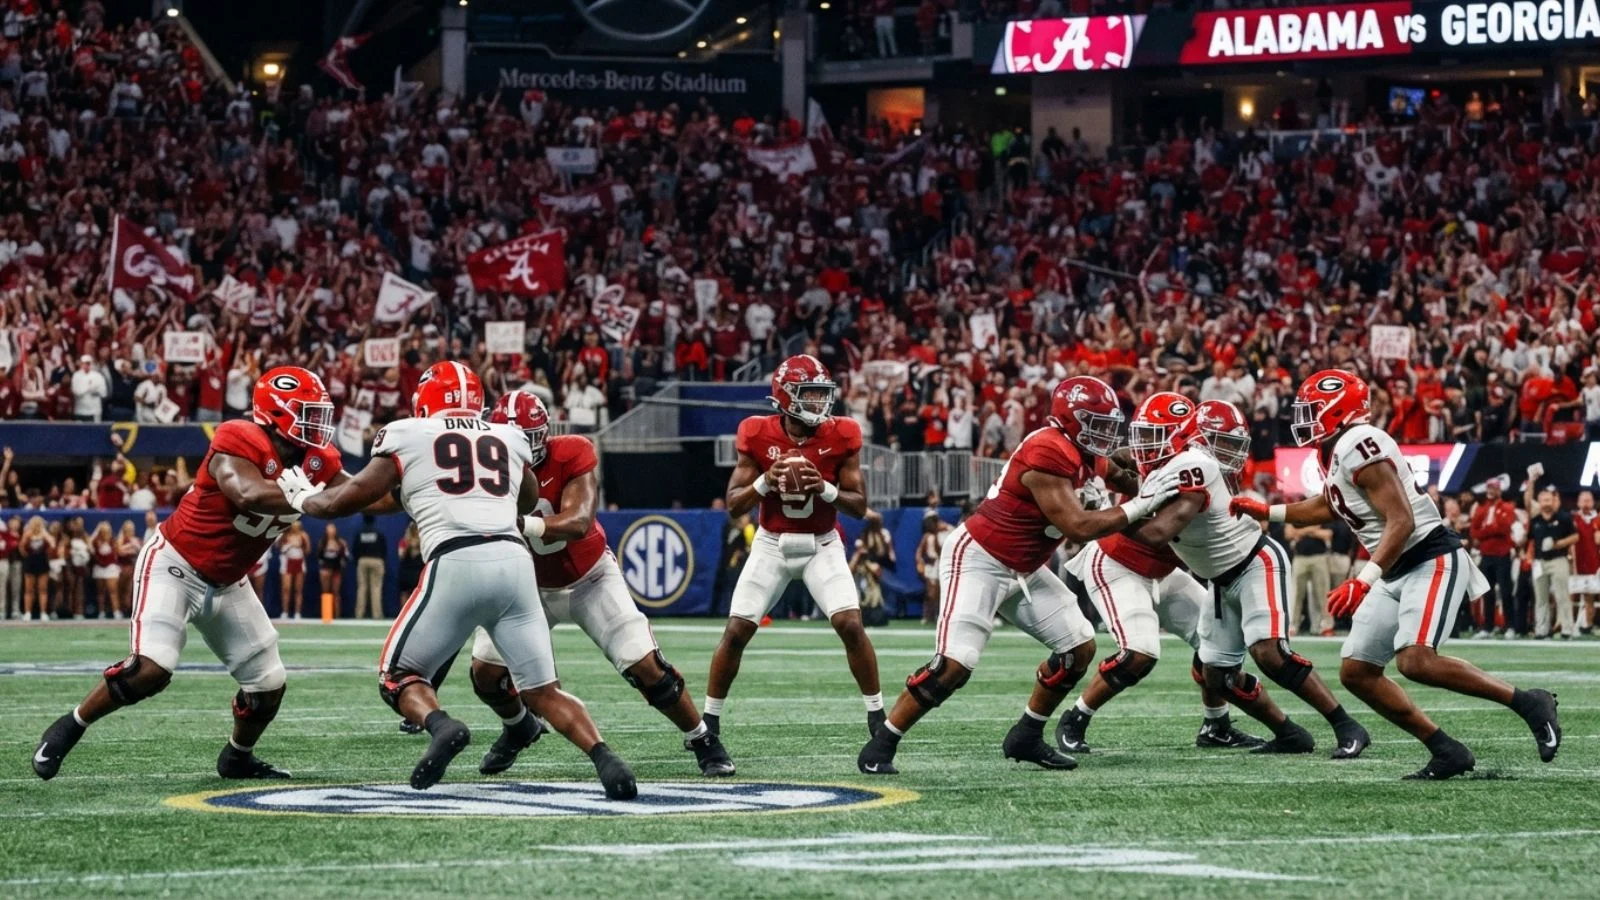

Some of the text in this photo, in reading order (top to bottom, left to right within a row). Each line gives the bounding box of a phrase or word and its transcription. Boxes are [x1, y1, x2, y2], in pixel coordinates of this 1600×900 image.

[1208, 9, 1384, 57] ALABAMA
[1440, 0, 1600, 45] GEORGIA
[500, 68, 746, 93] Mercedes-Benz Stadium
[433, 432, 510, 498] 99
[1355, 436, 1381, 461] 15
[1178, 467, 1205, 488] 99
[624, 523, 686, 599] SEC
